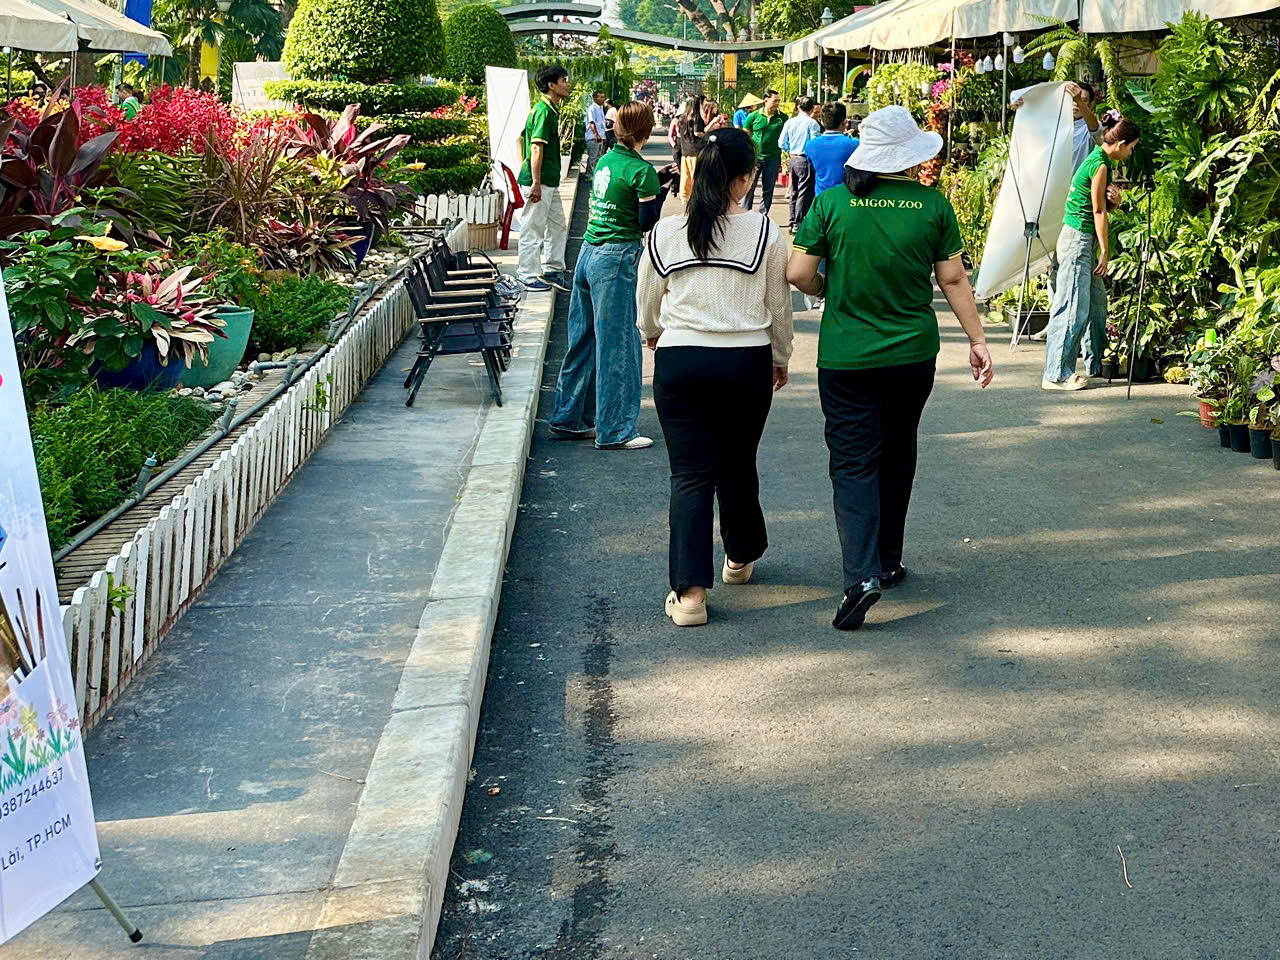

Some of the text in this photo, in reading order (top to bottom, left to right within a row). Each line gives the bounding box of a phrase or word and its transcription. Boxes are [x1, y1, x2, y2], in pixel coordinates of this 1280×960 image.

[850, 198, 923, 209] SAIGON ZOO
[1, 814, 72, 871] Lài, TP.HCM
